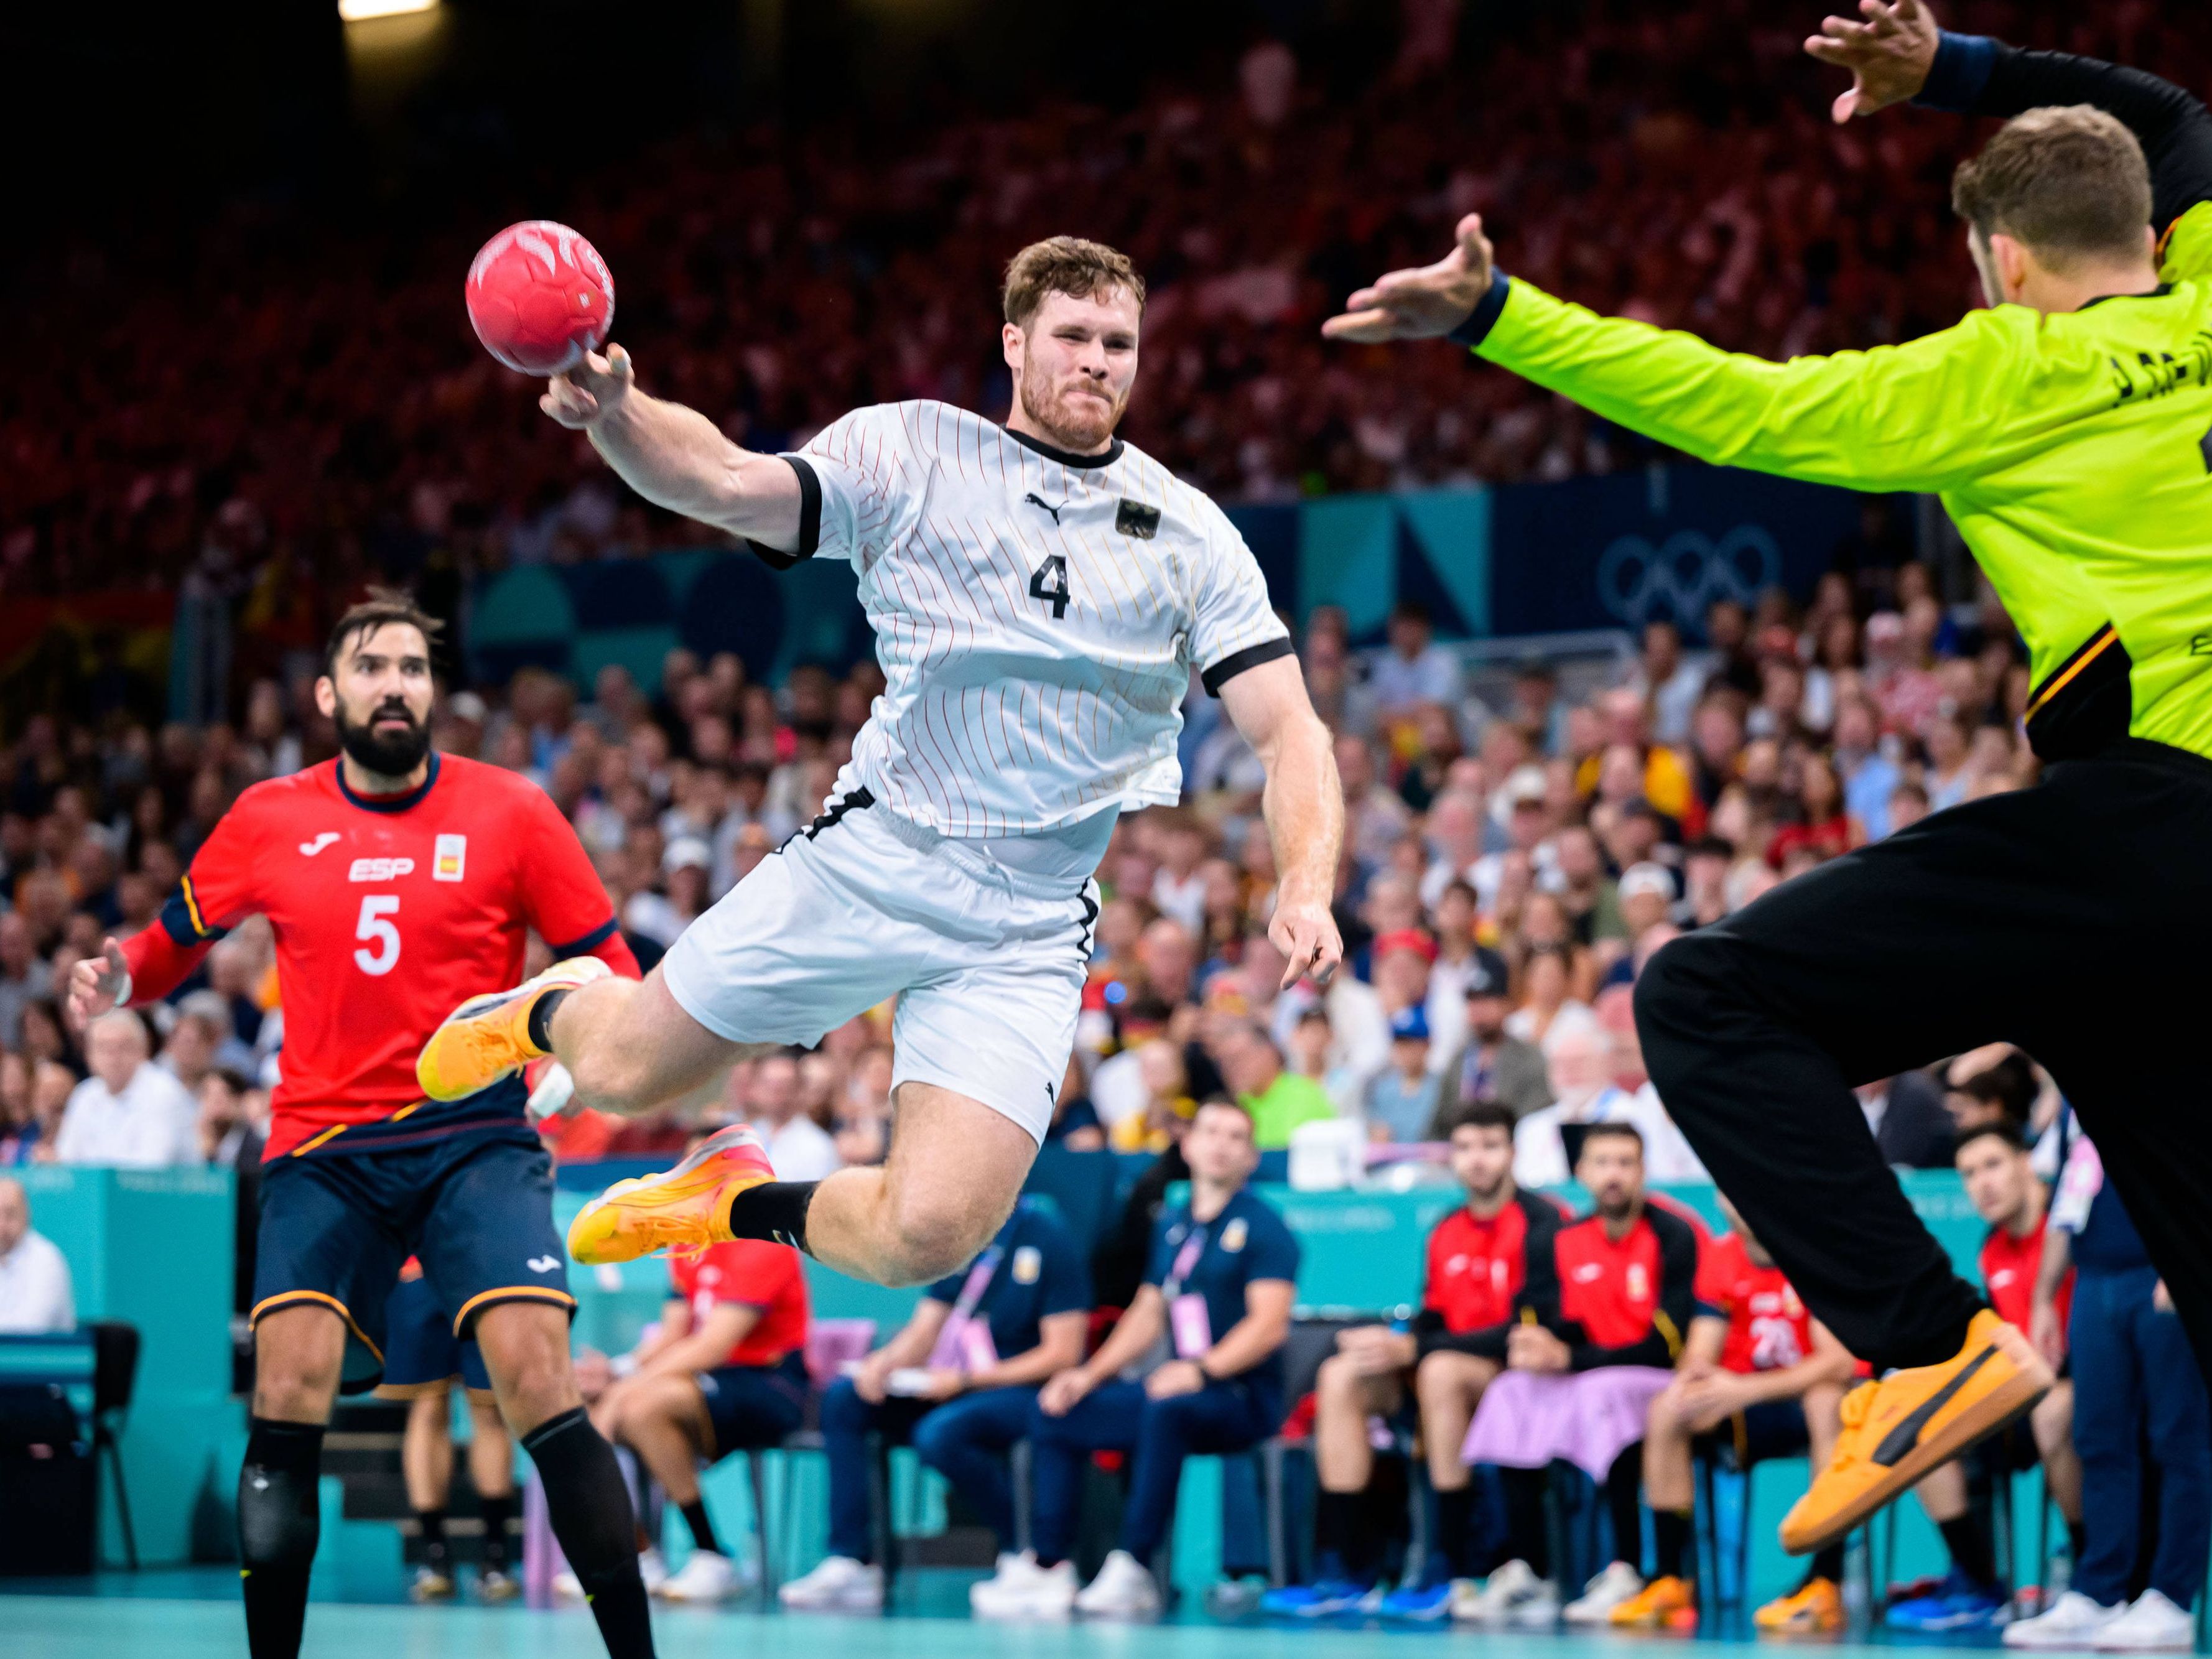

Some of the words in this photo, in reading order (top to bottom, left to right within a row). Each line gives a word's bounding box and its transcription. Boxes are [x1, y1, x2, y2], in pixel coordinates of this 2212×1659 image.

[1029, 554, 1071, 619] 4
[348, 858, 415, 882] ESP
[354, 895, 400, 975] 5
